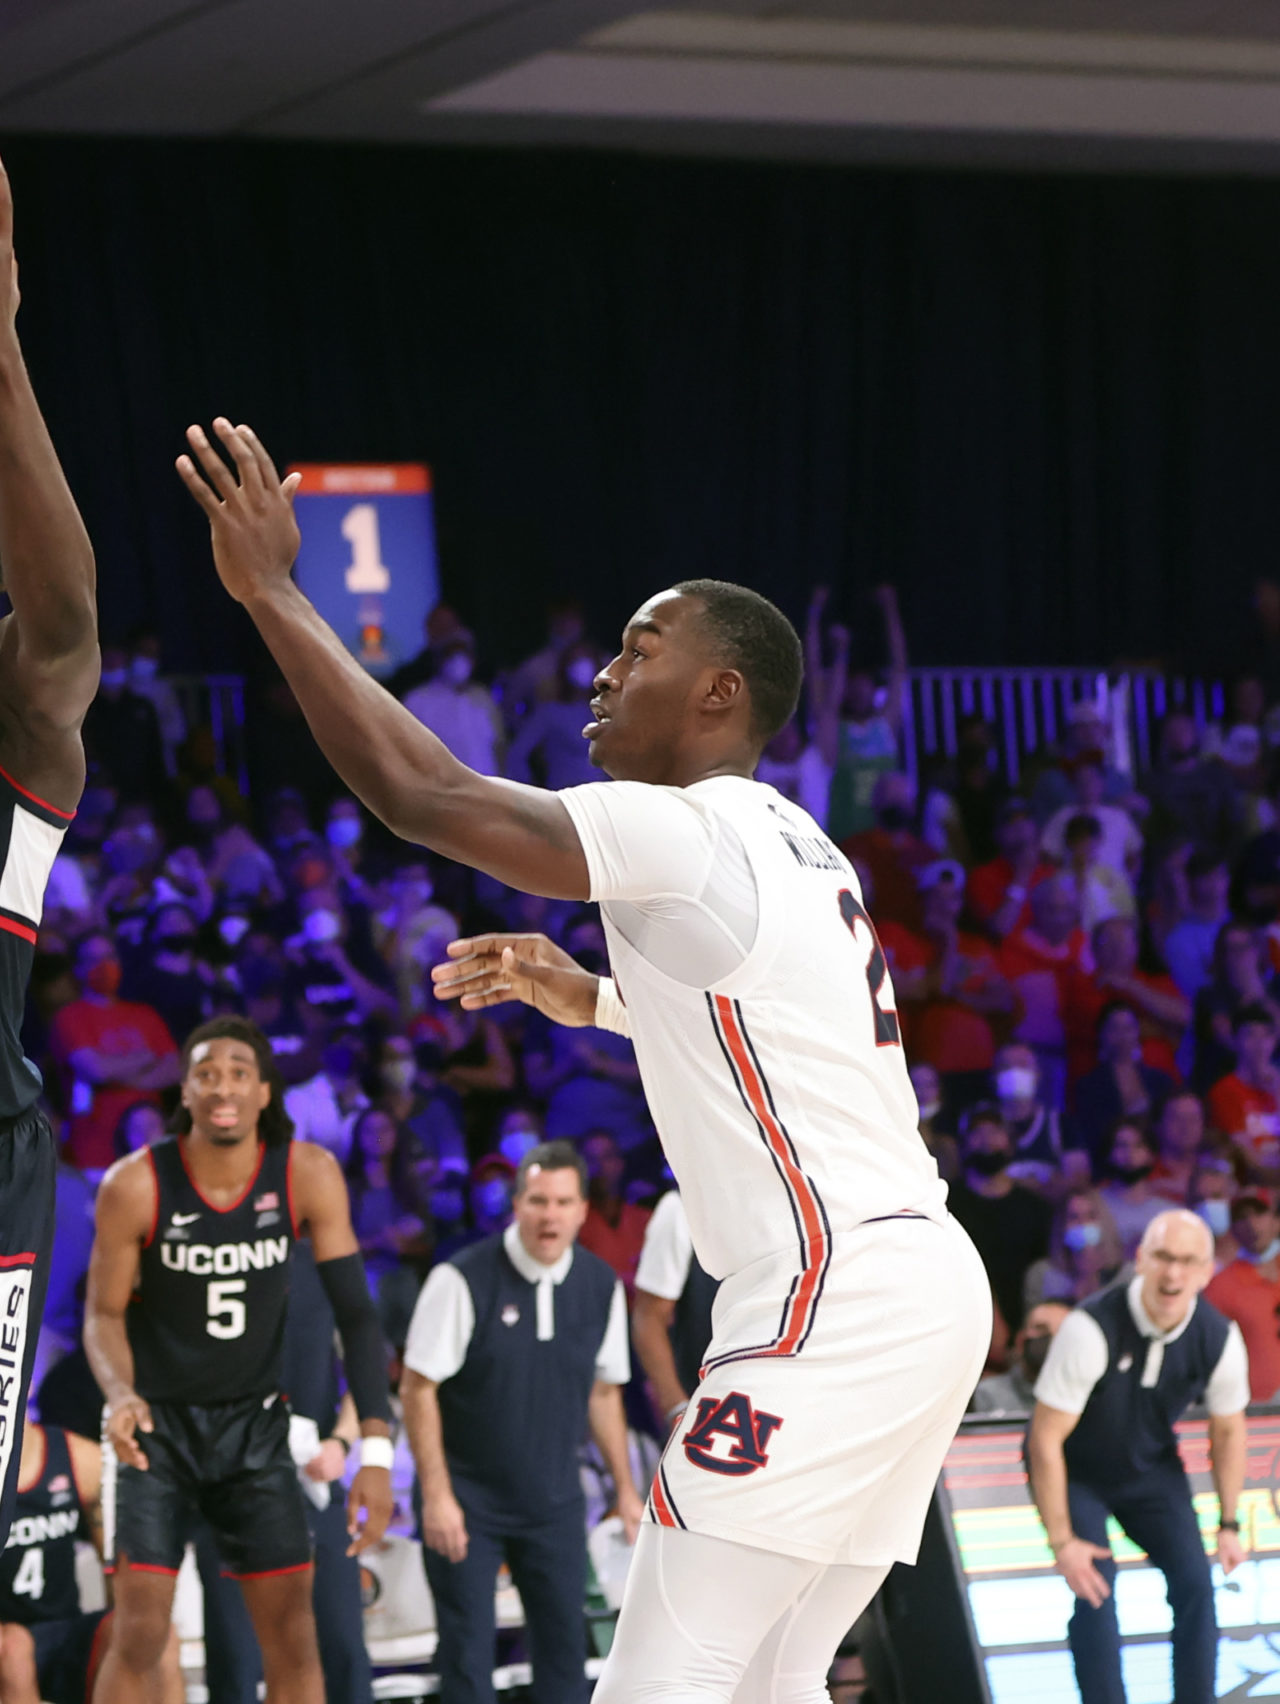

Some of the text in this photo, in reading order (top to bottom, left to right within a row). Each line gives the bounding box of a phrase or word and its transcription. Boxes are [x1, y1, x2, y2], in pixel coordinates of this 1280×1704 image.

[341, 503, 390, 594] 1
[837, 887, 901, 1048] 2
[160, 1235, 288, 1275] UCONN
[206, 1279, 246, 1340] 5
[12, 1547, 45, 1600] 4
